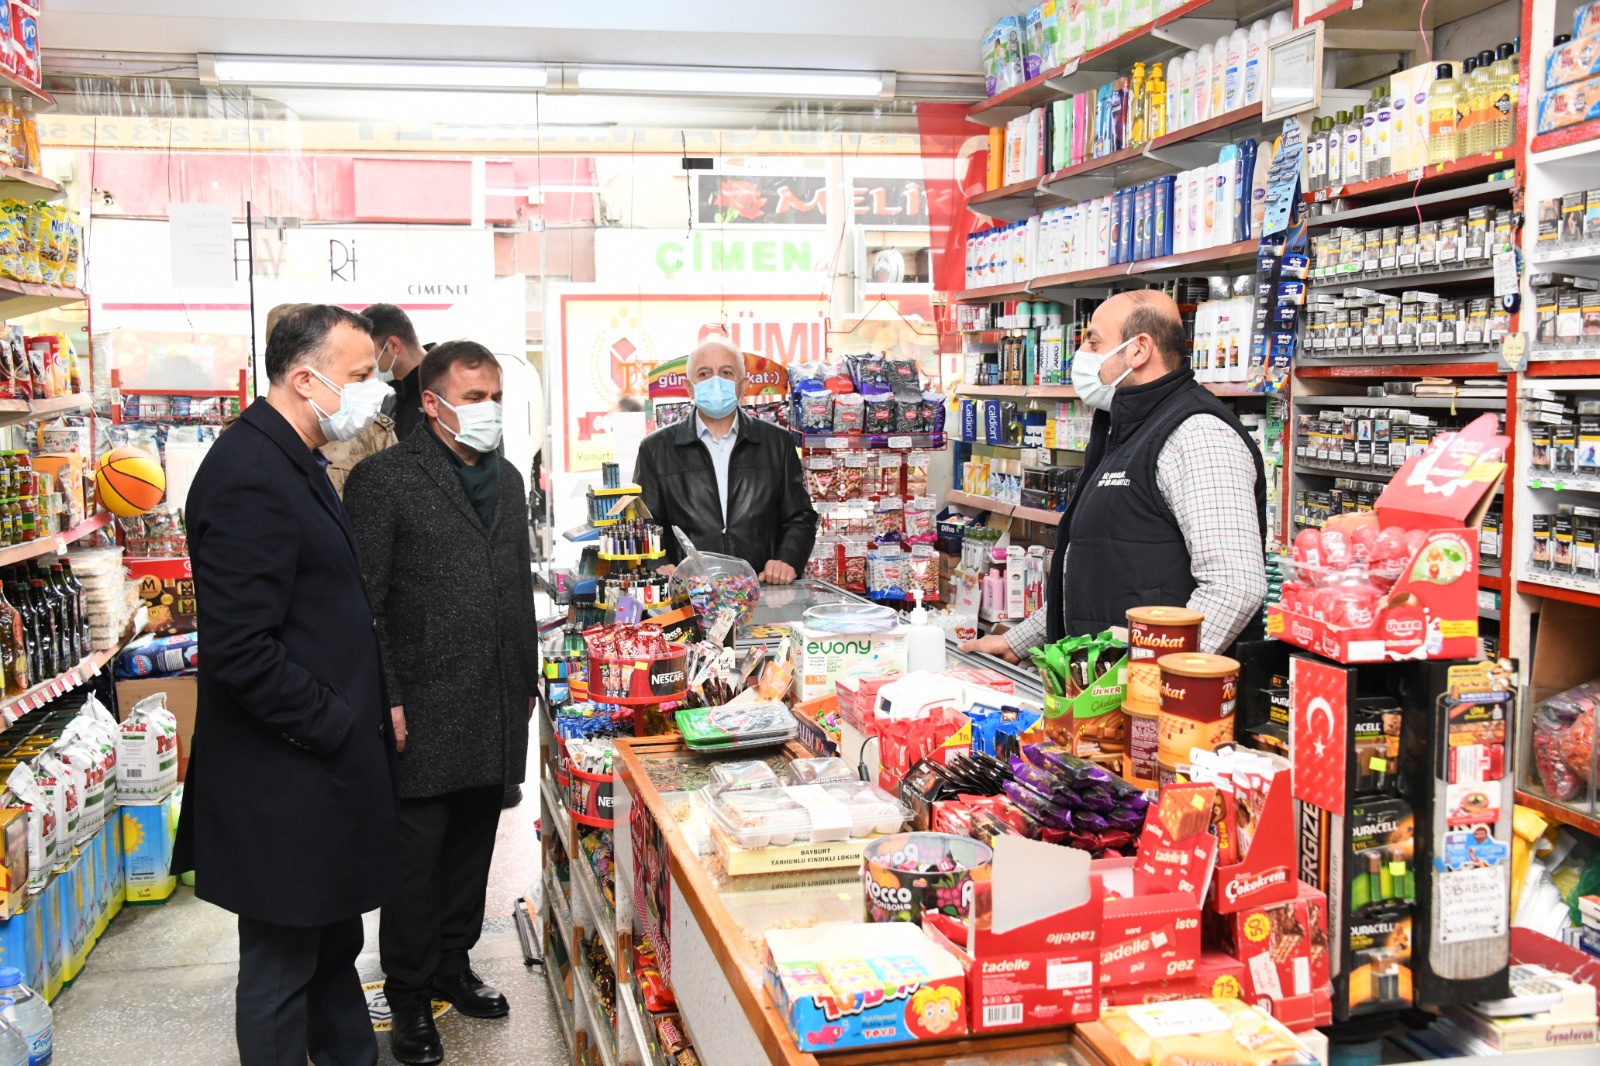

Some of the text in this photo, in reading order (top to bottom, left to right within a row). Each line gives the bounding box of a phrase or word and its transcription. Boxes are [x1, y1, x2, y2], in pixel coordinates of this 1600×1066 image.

[655, 231, 812, 280] ÇİMEN
[965, 403, 974, 437] caldion
[988, 404, 998, 440] caldion
[1385, 617, 1424, 632] ÜLKER
[1131, 628, 1186, 648] Rulokat
[806, 639, 871, 655] evony
[1091, 684, 1122, 696] ÜLKER
[800, 848, 831, 856] BAYBURT
[836, 853, 860, 862] LOKUM
[1225, 869, 1286, 905] Çokokrem
[1175, 917, 1199, 931] iste
[1046, 930, 1096, 944] tadelle
[981, 958, 1030, 974] tadelle
[1166, 958, 1195, 976] gez
[1217, 979, 1235, 998] 75
[861, 1020, 882, 1028] Bubble
[863, 1028, 897, 1039] TOYS
